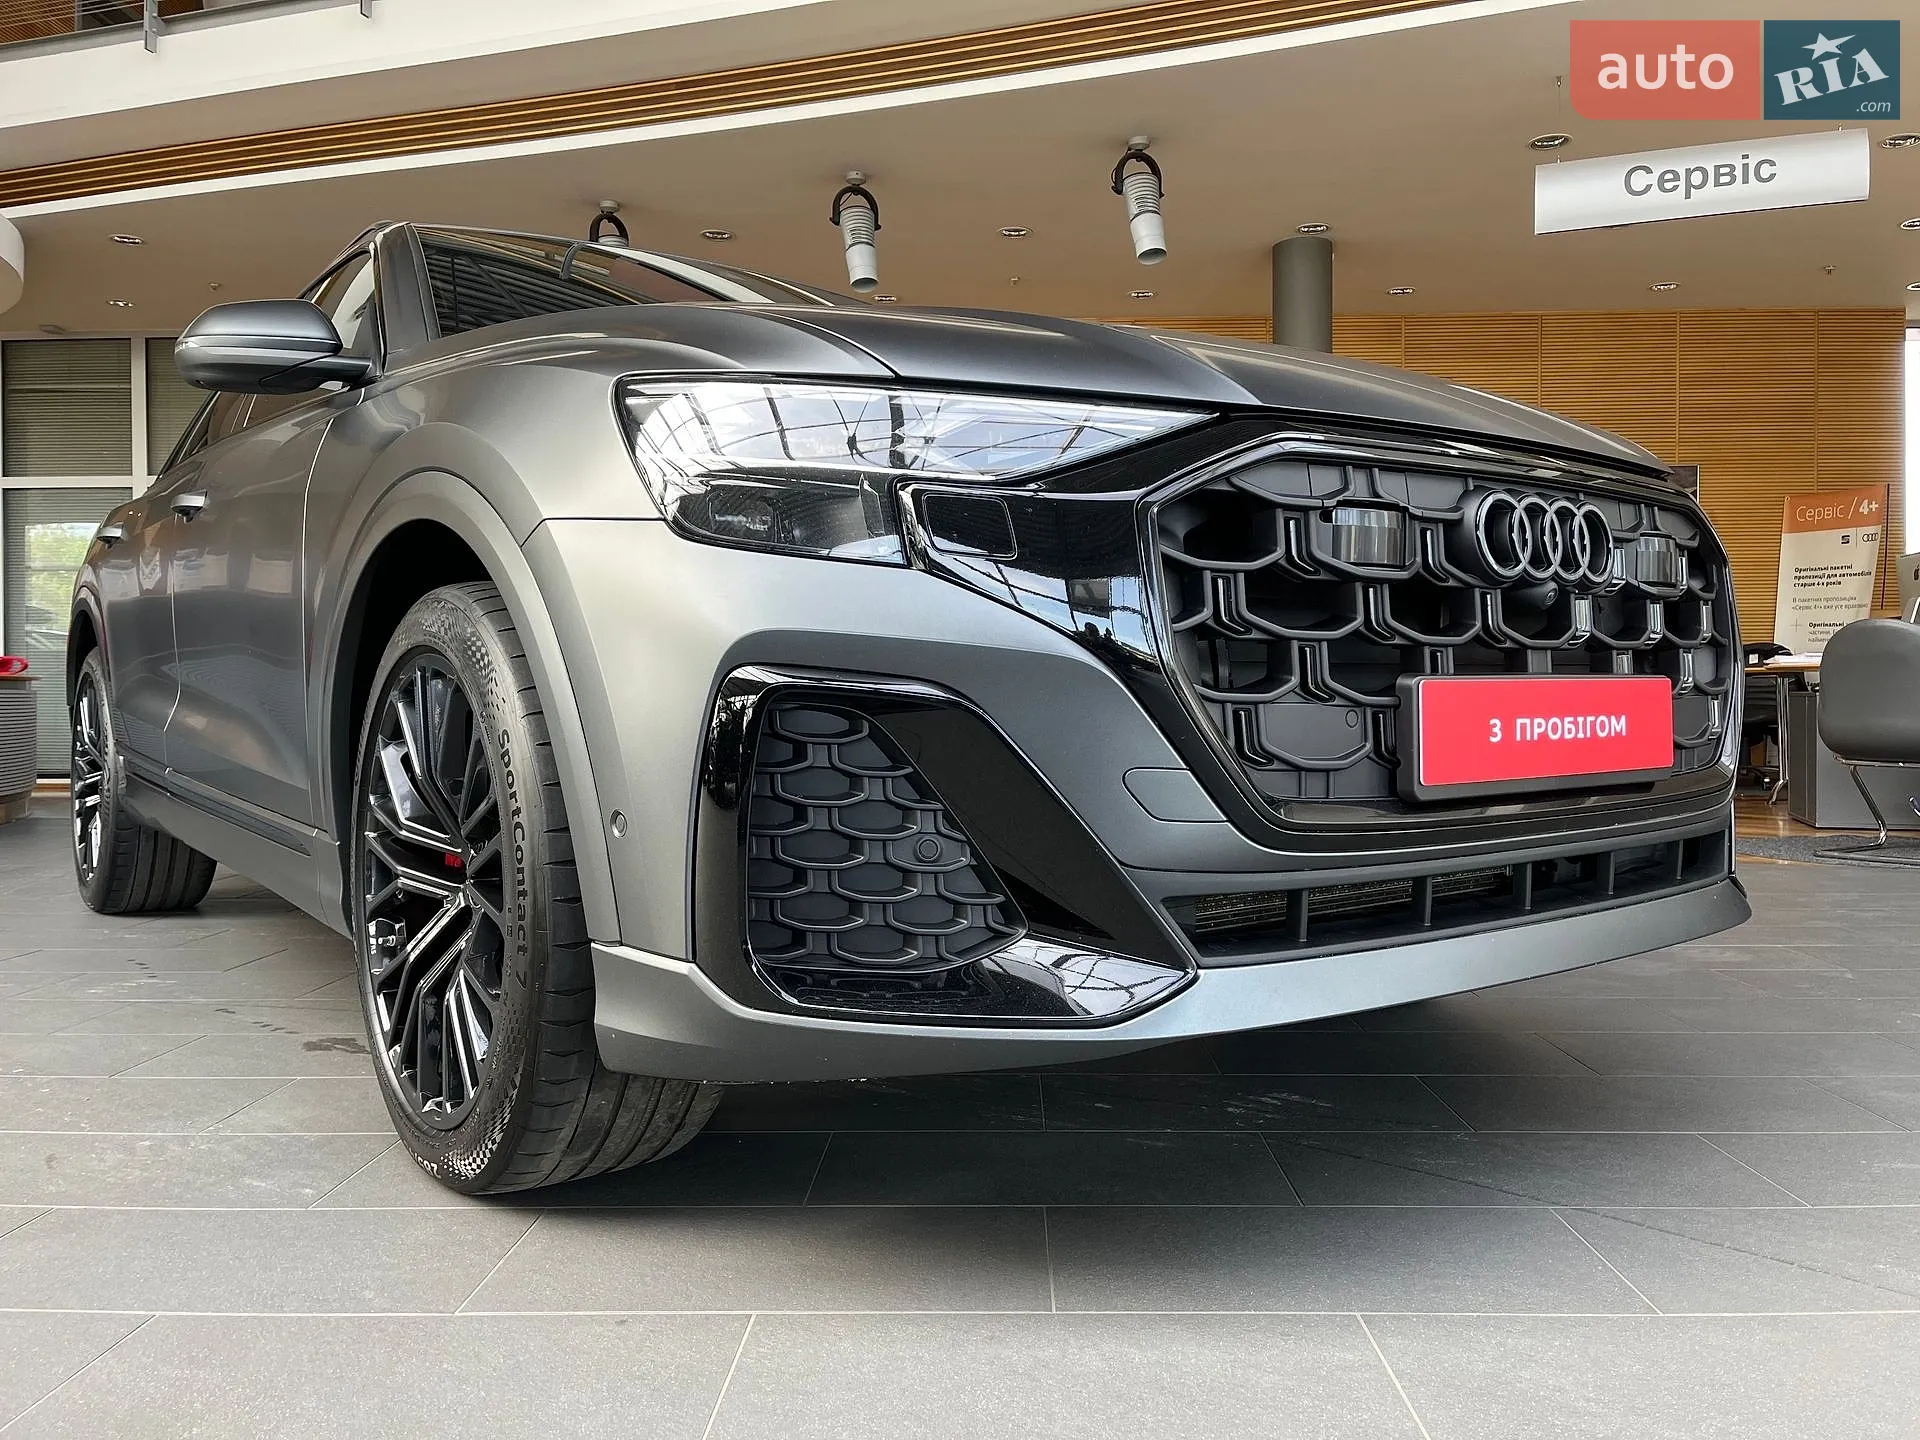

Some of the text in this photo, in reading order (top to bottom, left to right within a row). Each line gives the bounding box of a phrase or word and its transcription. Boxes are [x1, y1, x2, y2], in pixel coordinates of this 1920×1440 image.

[1624, 154, 1778, 199] Сервіс
[1796, 502, 1845, 524] Сервіс
[1516, 715, 1627, 741] ПРОБІГОМ
[498, 728, 528, 989] SportContact 7
